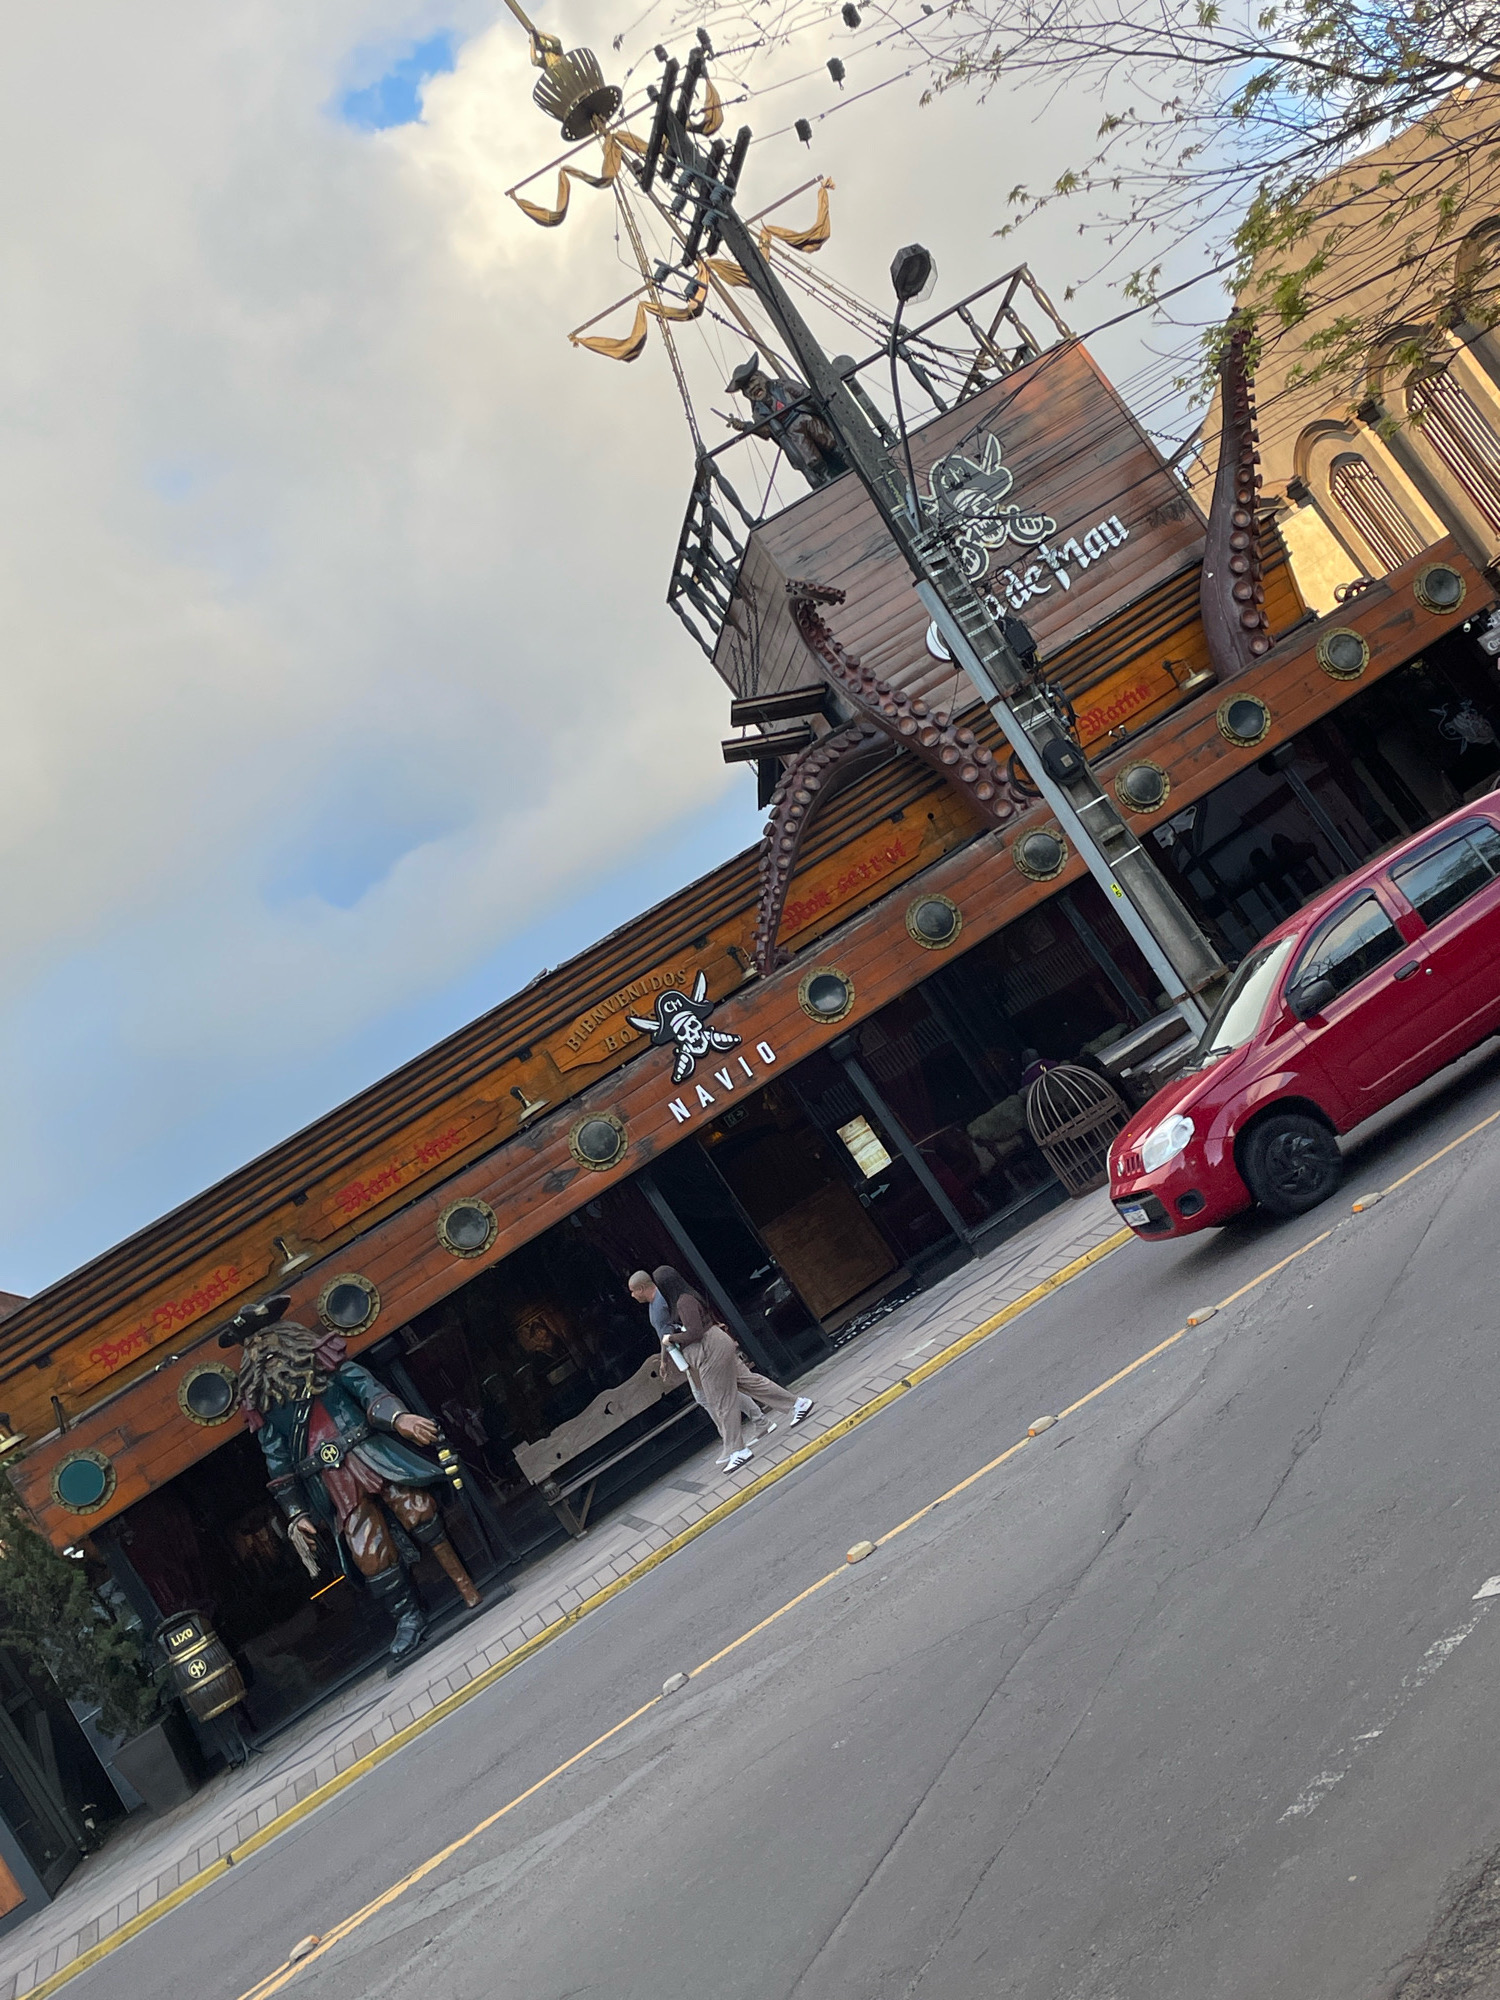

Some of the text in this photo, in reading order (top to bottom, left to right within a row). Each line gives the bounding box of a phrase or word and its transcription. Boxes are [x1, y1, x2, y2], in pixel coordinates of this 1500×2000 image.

[1037, 515, 1130, 591] Mau
[565, 969, 687, 1052] BIENVENIDOS
[668, 1041, 777, 1123] NAVIO
[170, 1628, 194, 1647] LIXO
